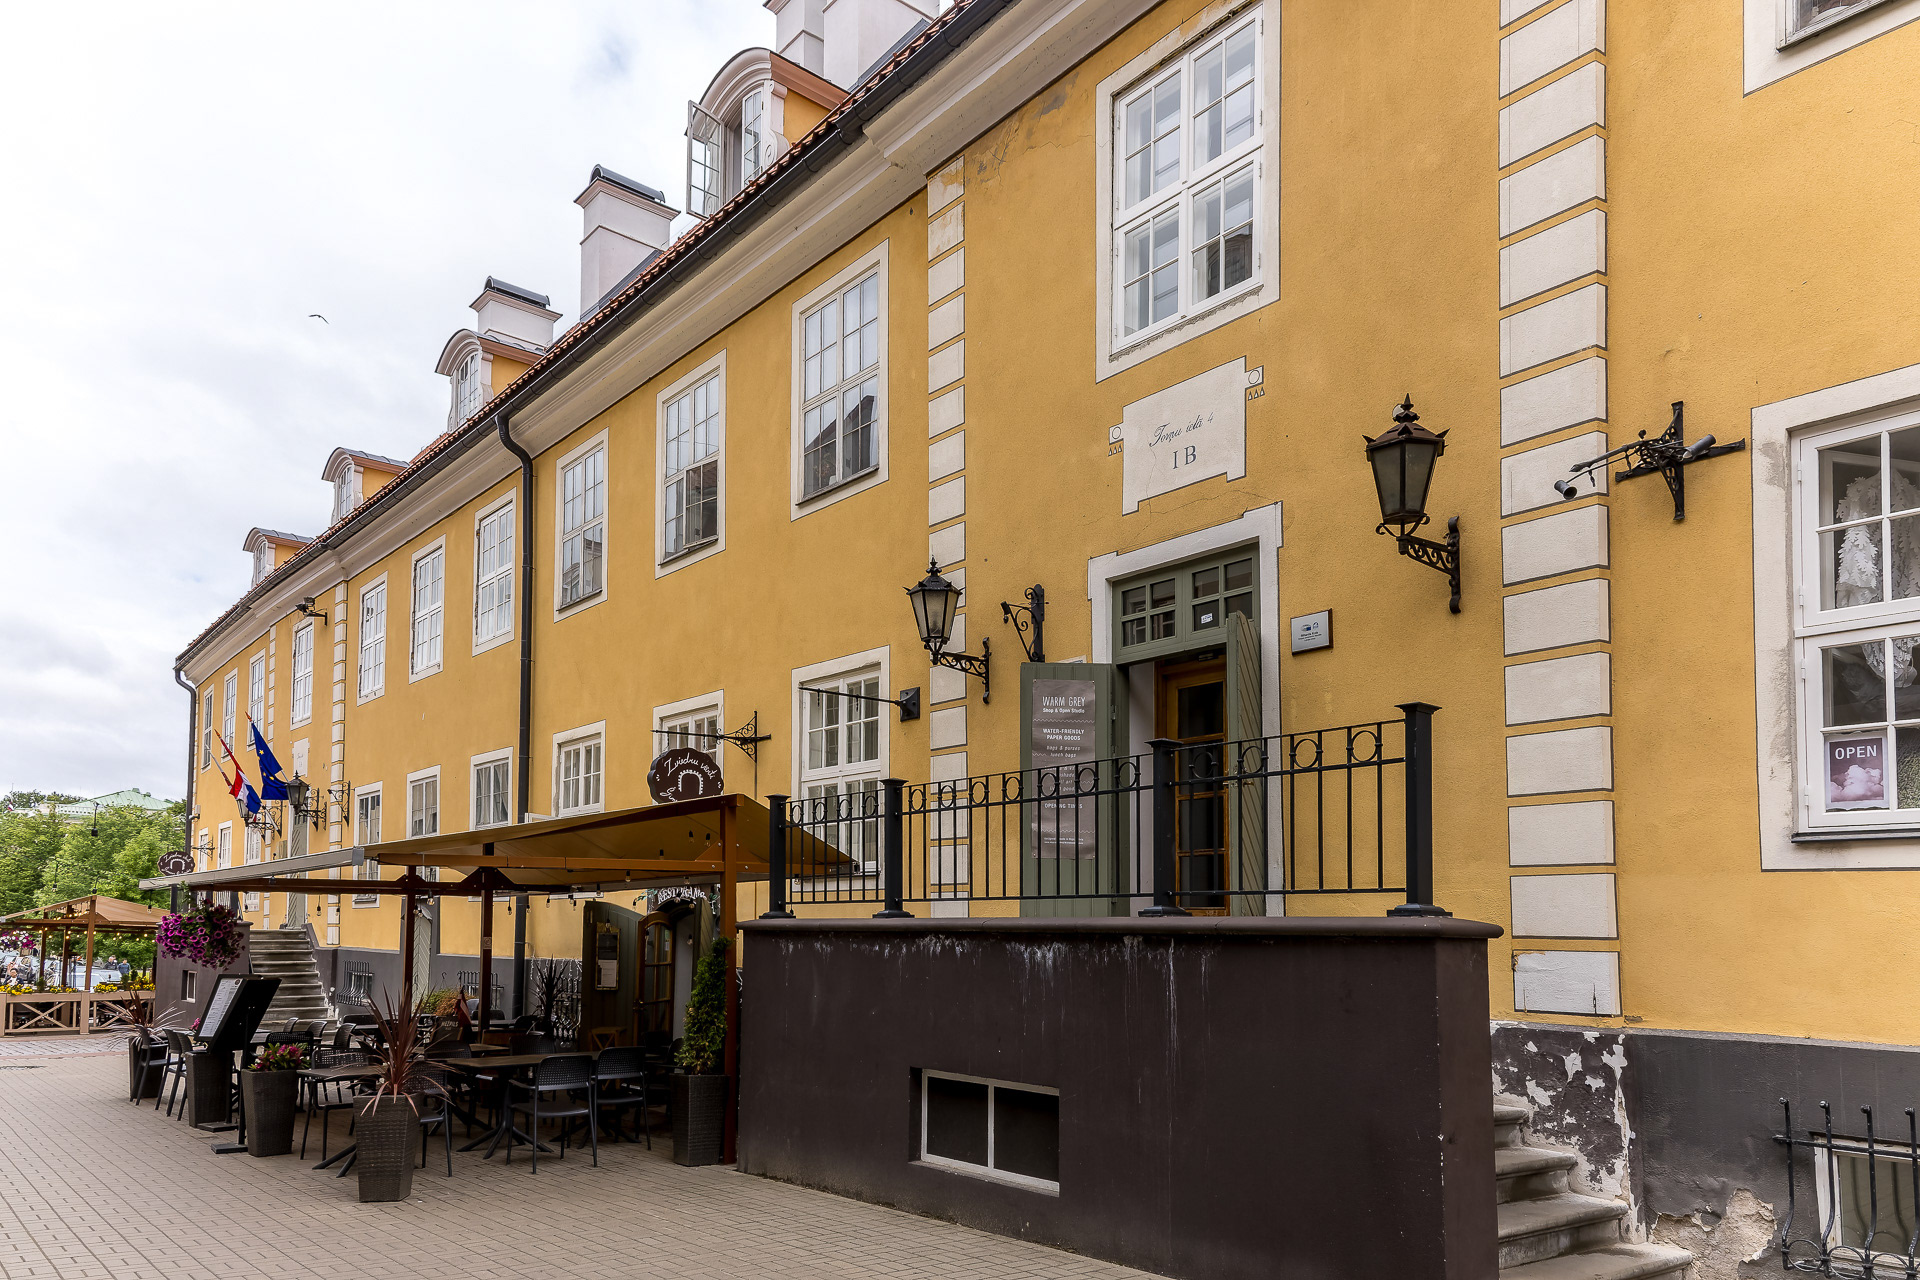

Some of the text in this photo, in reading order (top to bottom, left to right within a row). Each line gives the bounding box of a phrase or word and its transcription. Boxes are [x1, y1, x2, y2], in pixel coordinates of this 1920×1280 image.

[1207, 411, 1214, 423] 4
[1042, 696, 1086, 707] WARM GREY
[1834, 744, 1877, 760] OPEN
